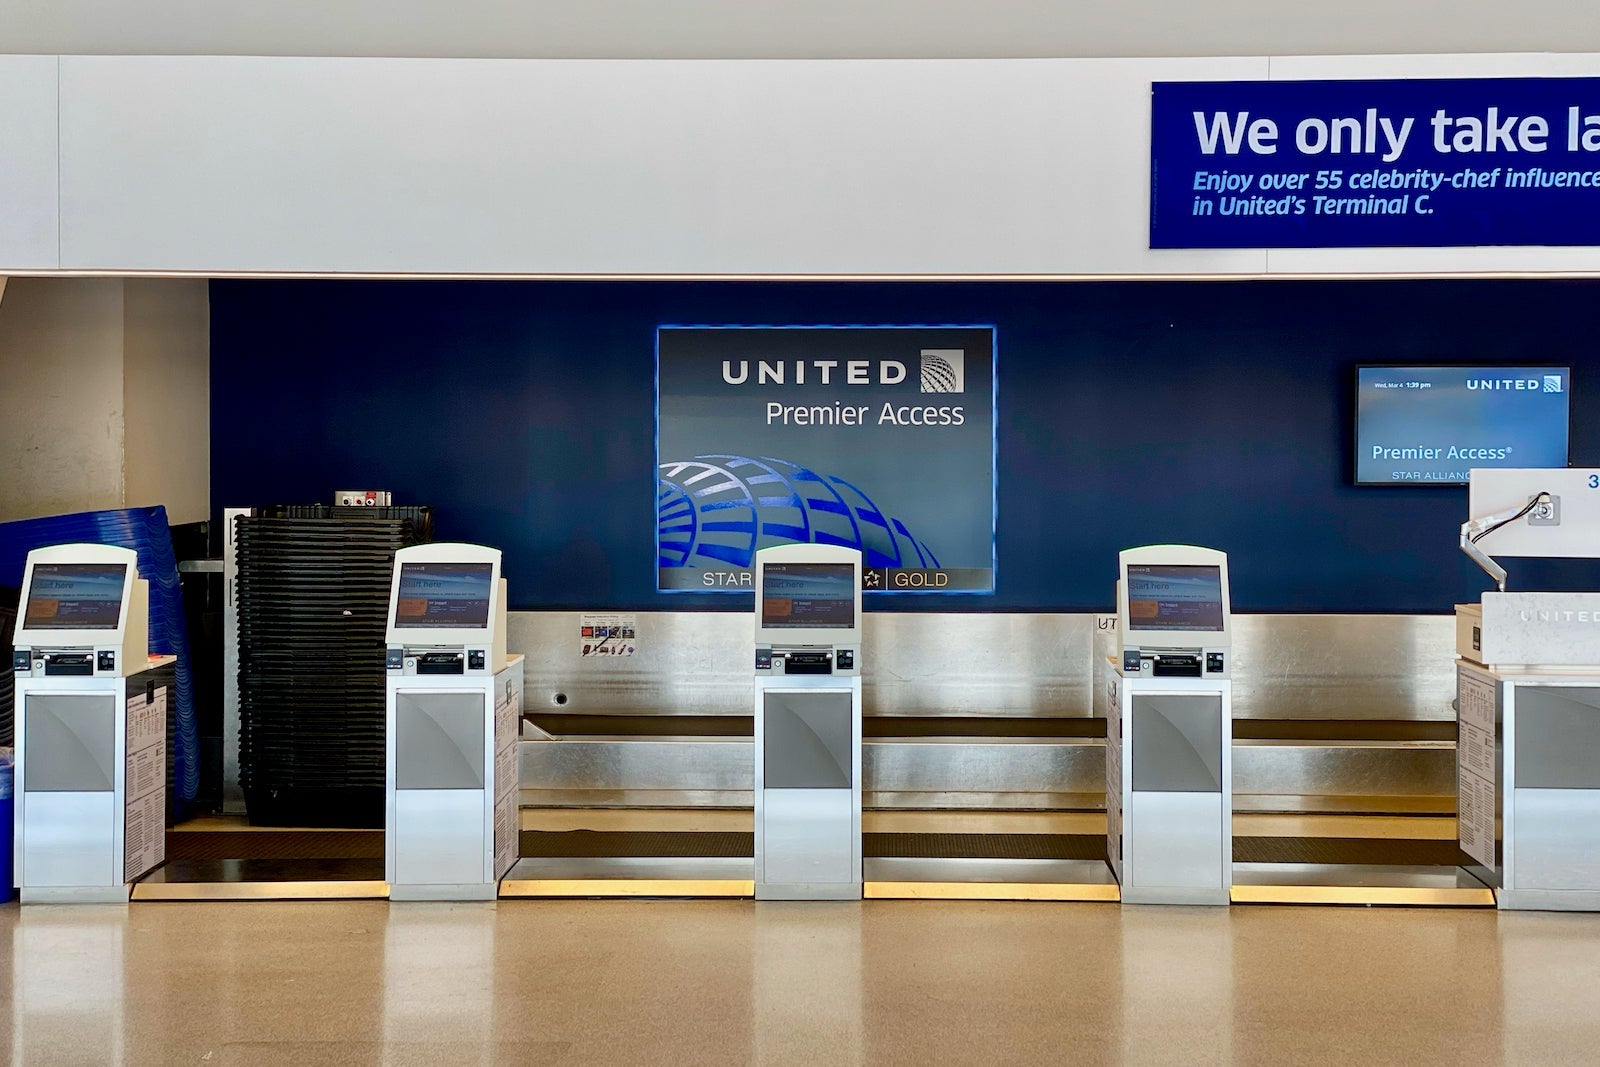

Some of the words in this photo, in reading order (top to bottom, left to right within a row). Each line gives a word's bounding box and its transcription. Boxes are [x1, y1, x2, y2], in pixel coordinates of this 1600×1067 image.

[1193, 108, 1279, 156] We
[1295, 106, 1415, 164] only
[1430, 105, 1549, 154] take
[1567, 105, 1600, 152] la
[1193, 169, 1252, 194] Enjoy
[1259, 173, 1309, 191] over
[1315, 170, 1344, 190] 55
[1349, 167, 1502, 192] celebrity-chef
[1505, 166, 1600, 189] influence
[1192, 195, 1214, 217] in
[1219, 194, 1307, 217] United's
[1313, 194, 1408, 216] Terminal
[1414, 194, 1435, 216] C.
[722, 360, 907, 385] UNITED
[1466, 379, 1540, 391] UNITED
[765, 401, 870, 426] Premier
[877, 402, 966, 427] Access
[1372, 445, 1442, 460] Premier
[1392, 471, 1421, 480] STAR
[1588, 474, 1600, 489] 3
[702, 571, 753, 586] STAR
[894, 572, 948, 587] GOLD
[1151, 582, 1170, 590] here
